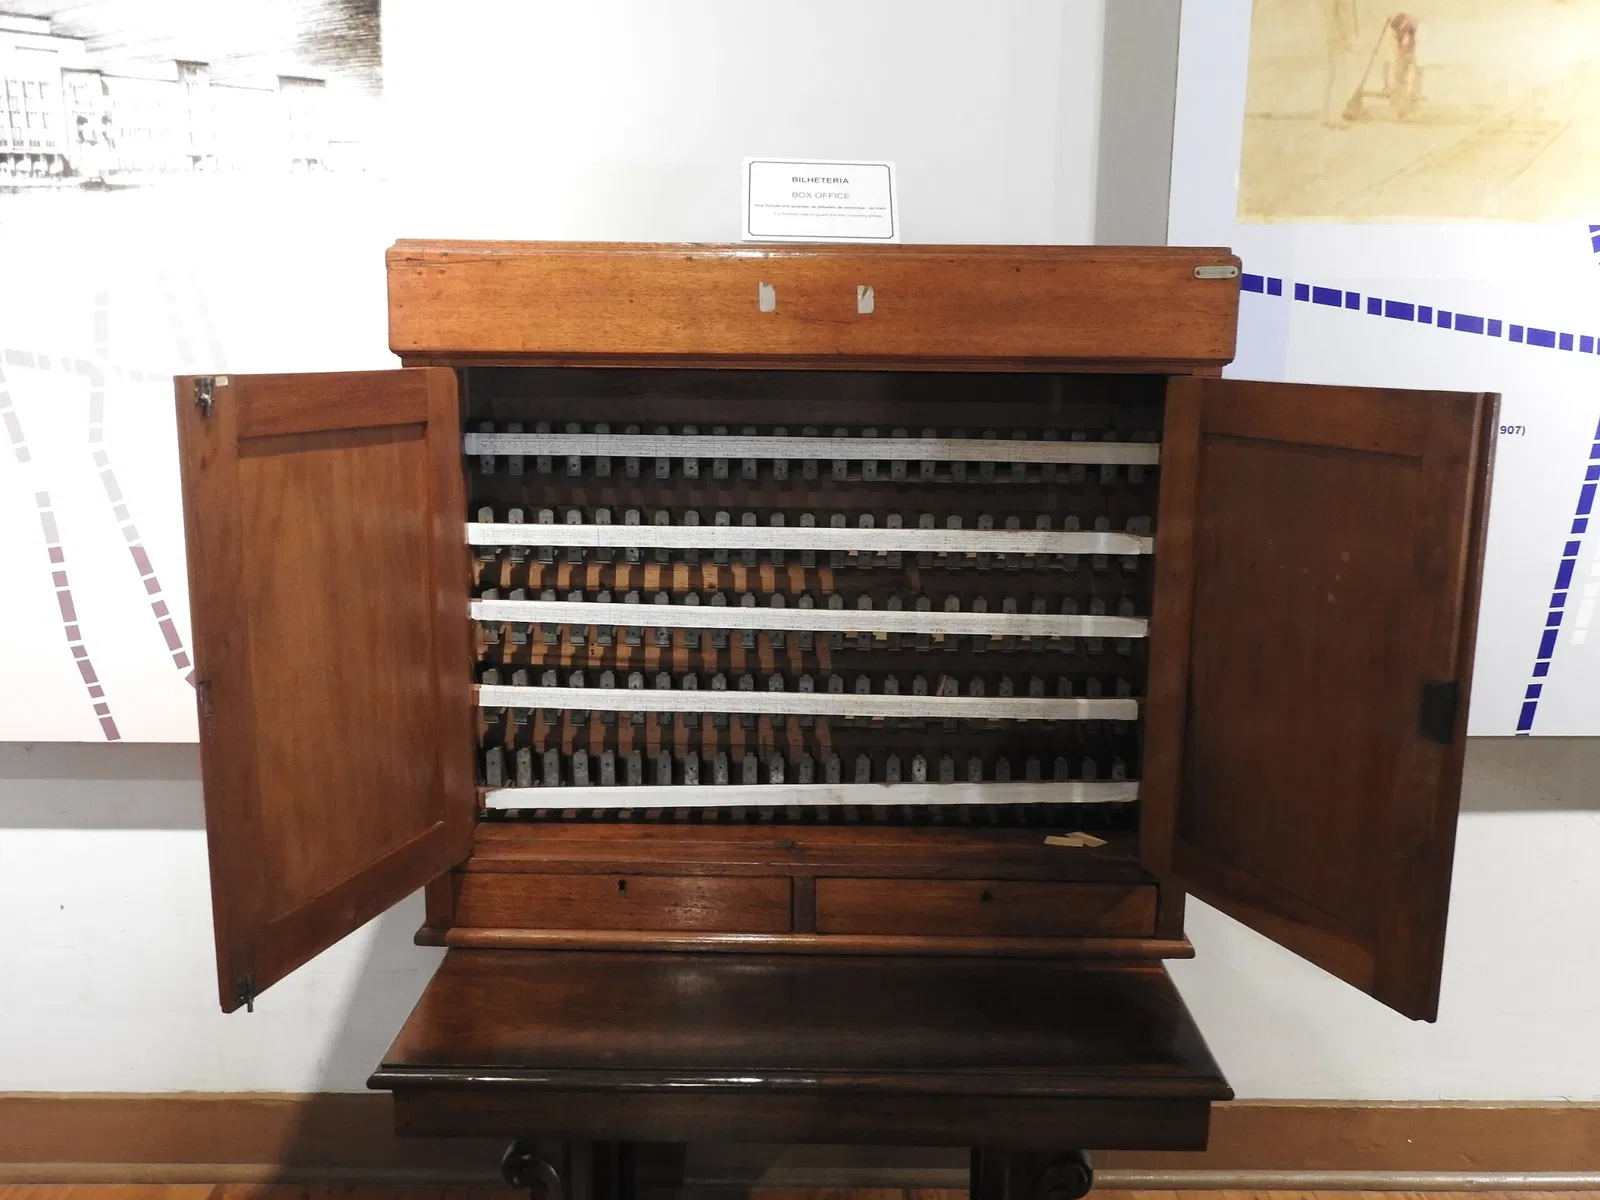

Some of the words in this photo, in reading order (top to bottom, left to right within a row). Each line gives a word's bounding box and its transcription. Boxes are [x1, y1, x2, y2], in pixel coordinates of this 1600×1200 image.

[791, 176, 850, 184] BILHETERIA
[791, 191, 812, 199] BOX
[814, 192, 850, 200] OFFICE
[1499, 425, 1526, 436] 907)
